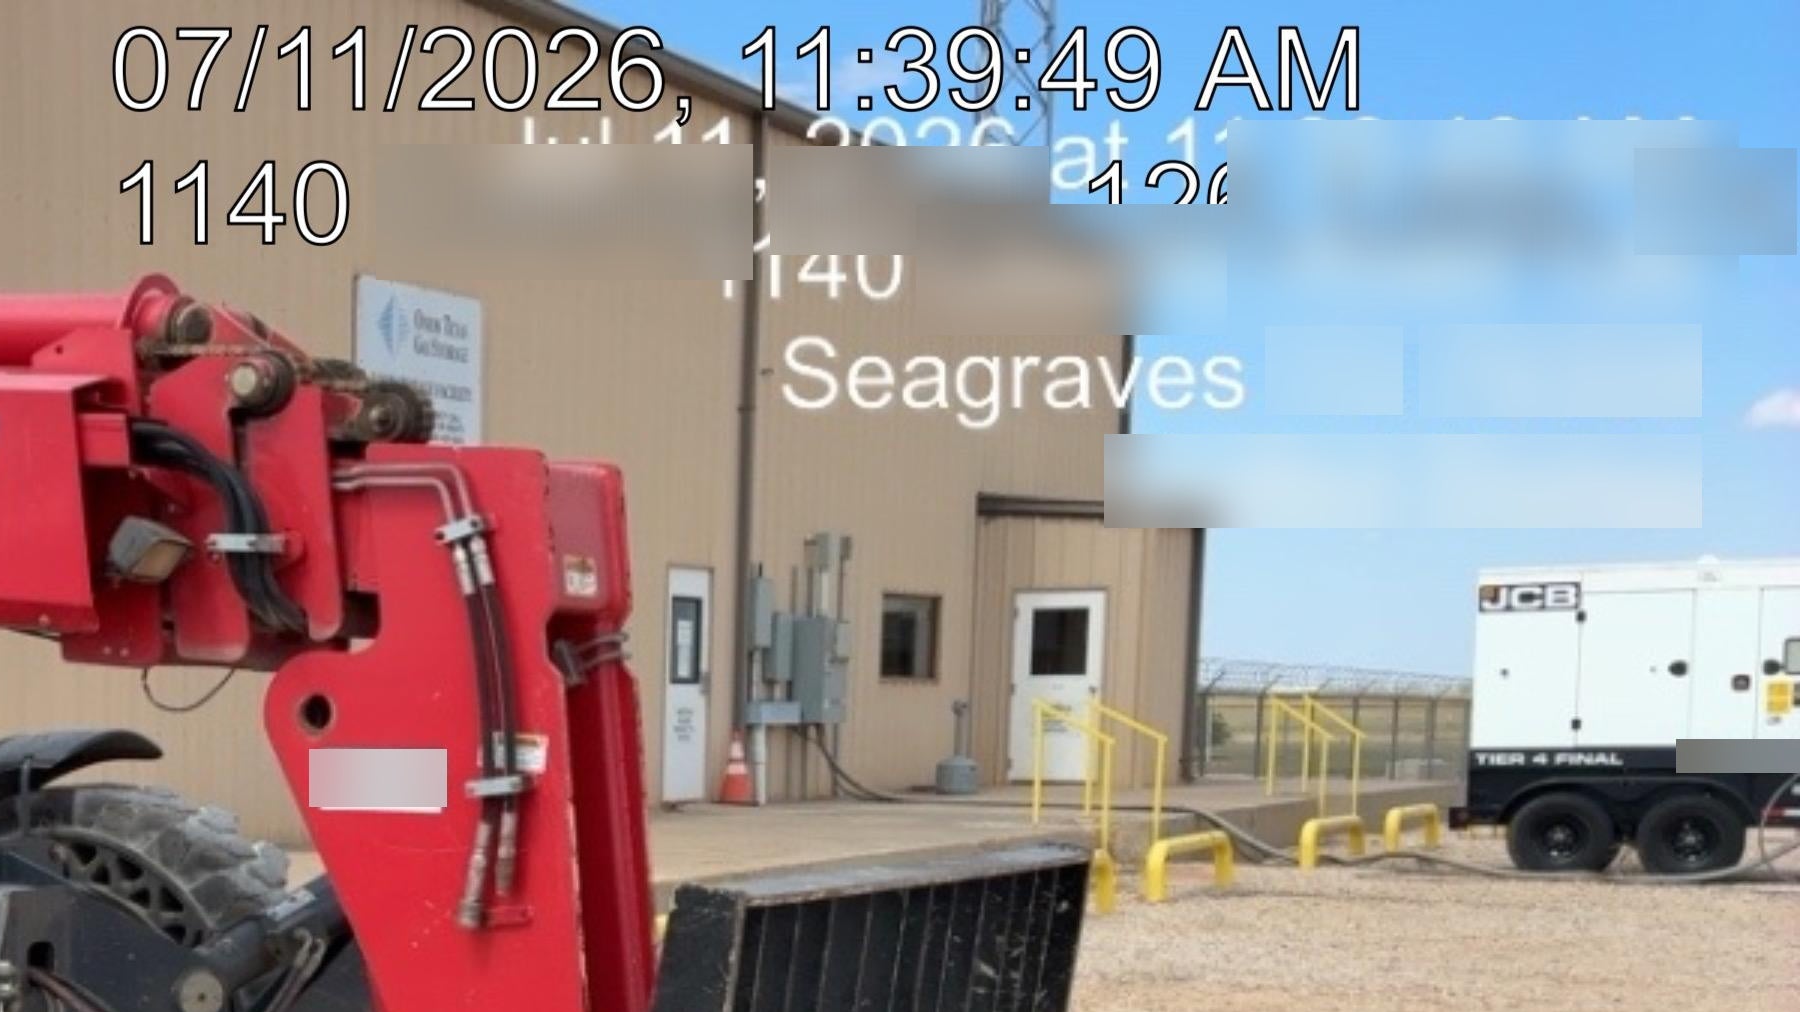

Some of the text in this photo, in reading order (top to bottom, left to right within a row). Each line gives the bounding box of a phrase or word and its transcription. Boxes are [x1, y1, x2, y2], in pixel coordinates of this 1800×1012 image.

[1480, 583, 1579, 611] JCB
[1475, 752, 1624, 766] TIER 4 FINAL
